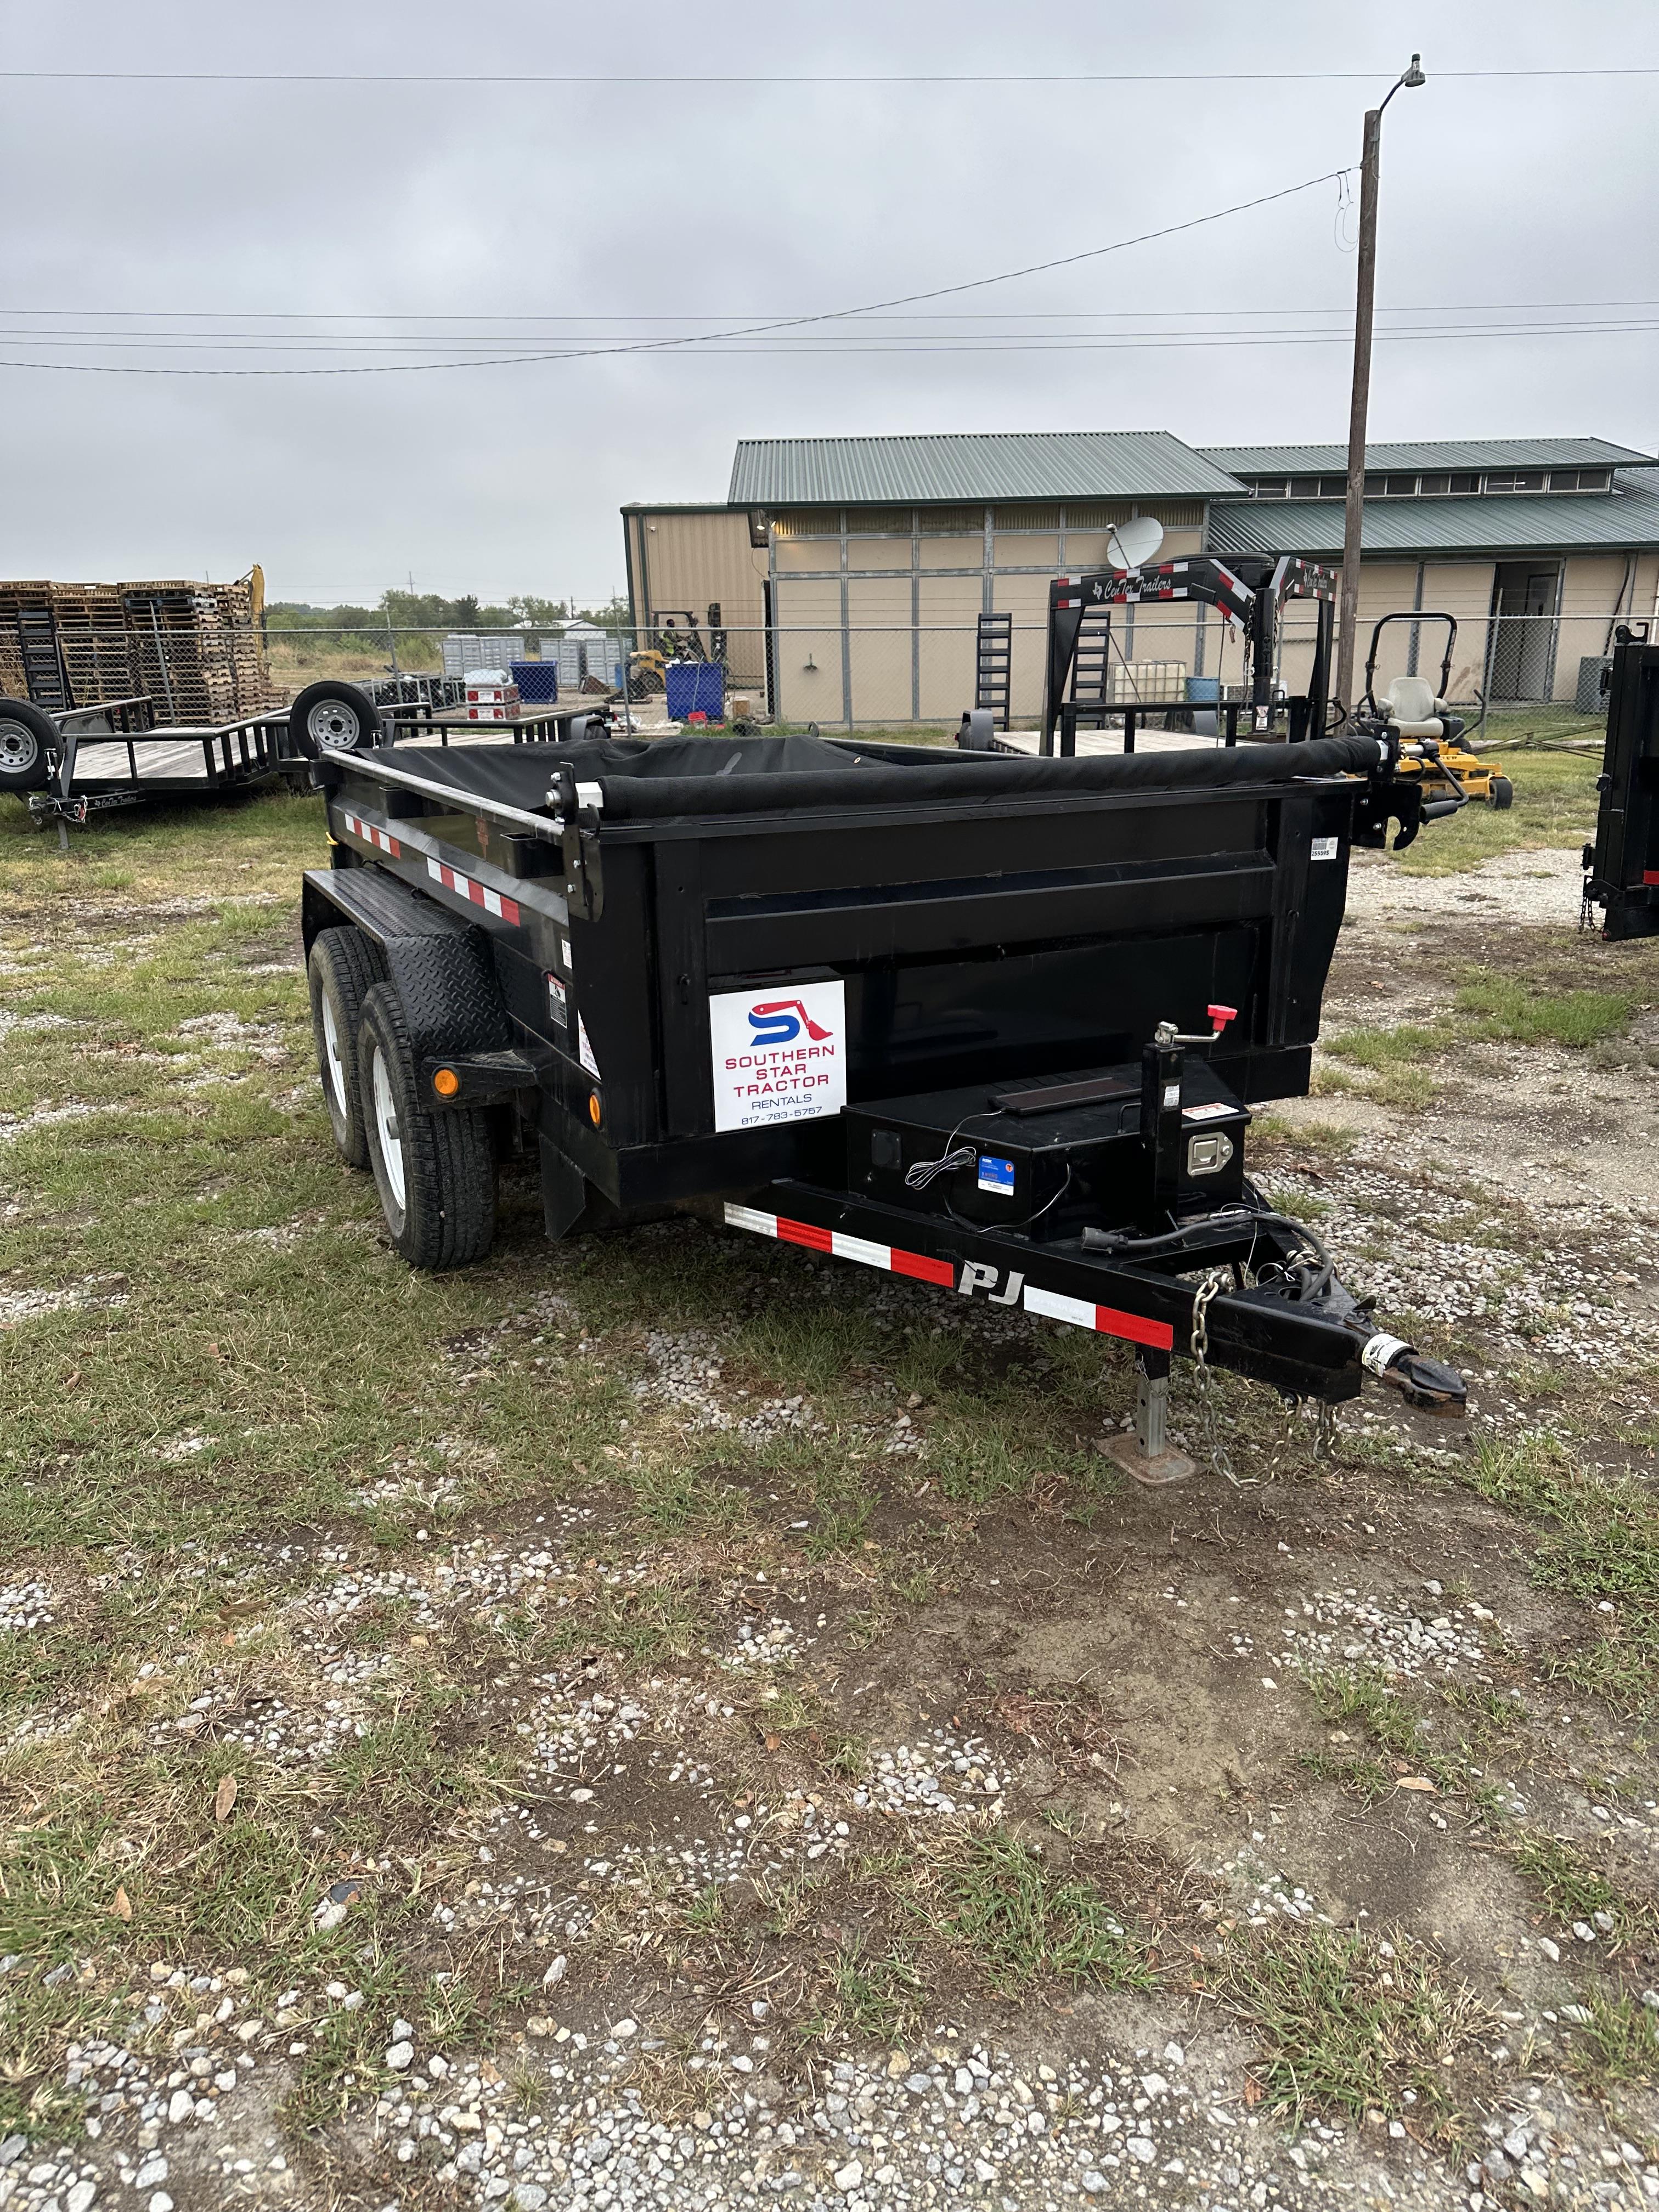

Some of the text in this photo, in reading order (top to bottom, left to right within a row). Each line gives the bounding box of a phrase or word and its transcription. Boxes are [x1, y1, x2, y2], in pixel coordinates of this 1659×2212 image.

[1136, 575, 1171, 594] Trailers
[725, 1045, 834, 1070] SOUTHERN
[756, 1064, 806, 1080] STAR
[733, 1075, 828, 1097] TRACTOR
[752, 1094, 812, 1110] RENTALS
[742, 1106, 822, 1125] 817-783-5757
[957, 1260, 1025, 1305] PJ
